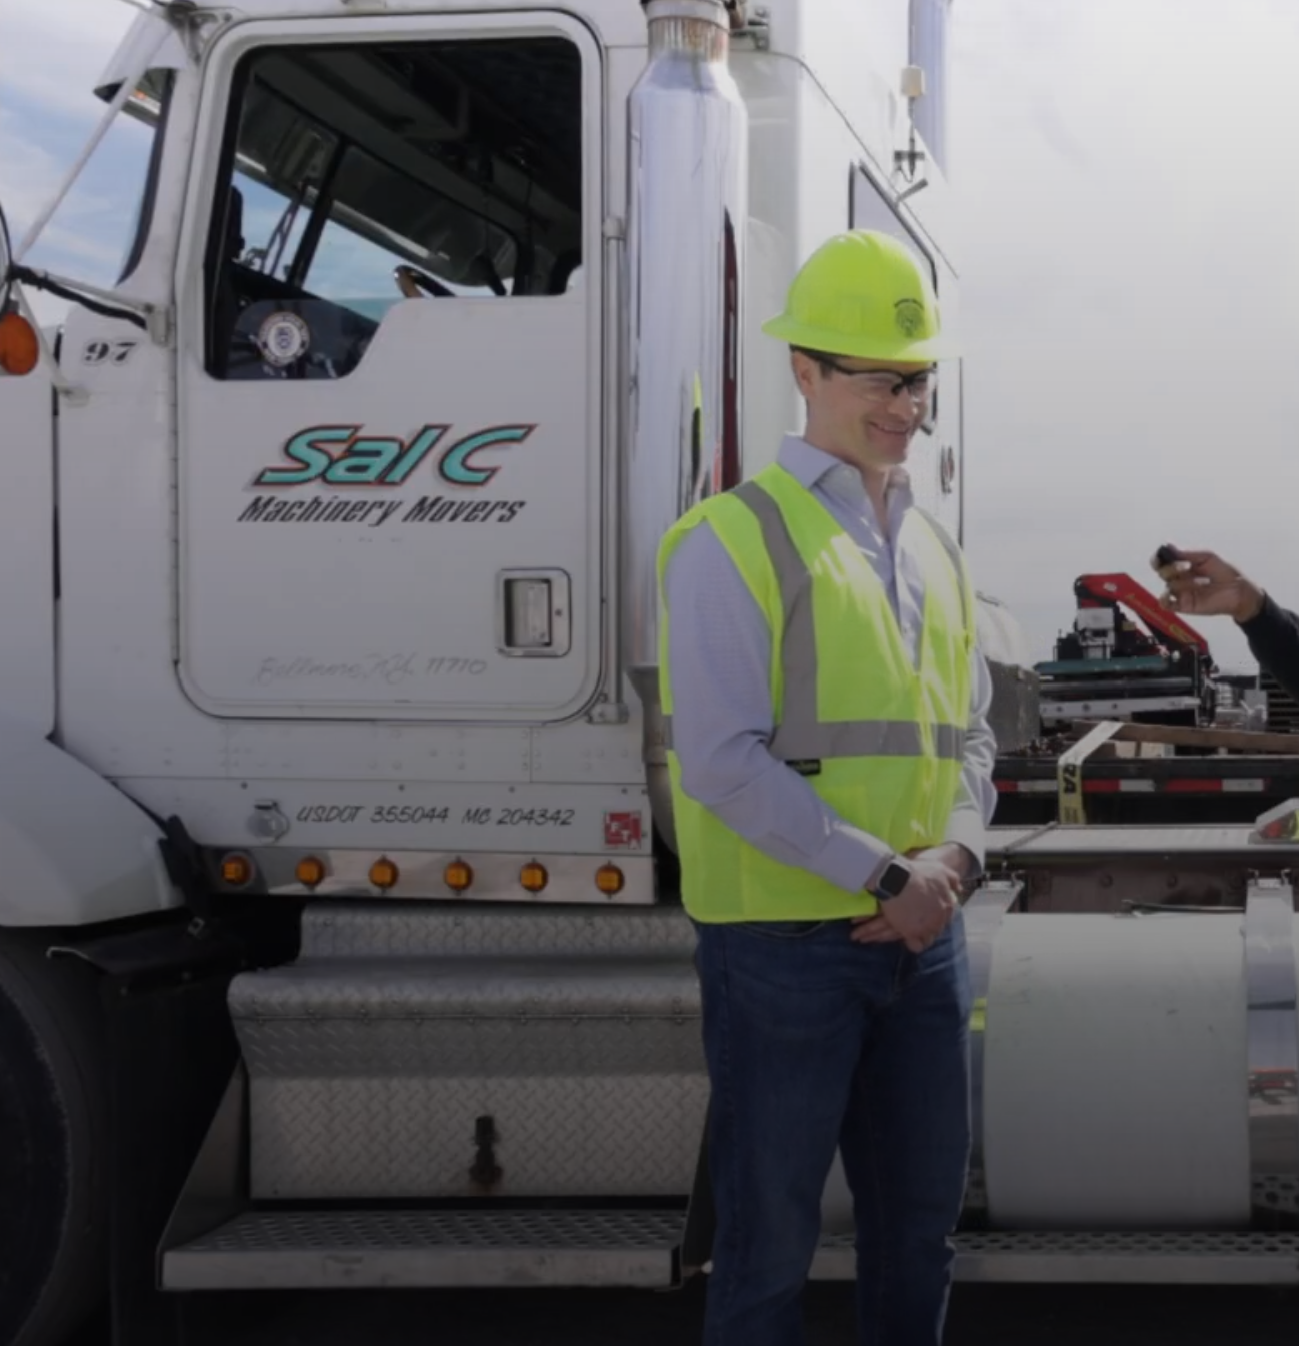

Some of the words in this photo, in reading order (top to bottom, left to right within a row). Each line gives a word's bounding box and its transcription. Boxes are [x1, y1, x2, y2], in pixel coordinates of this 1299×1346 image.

[84, 340, 137, 362] 97
[252, 424, 453, 486] Sal
[438, 424, 538, 486] C
[236, 495, 403, 527] Machinery
[401, 495, 527, 523] Movers
[425, 656, 488, 676] 11710
[296, 805, 365, 824] USDOT
[370, 805, 451, 824] 355044
[460, 807, 493, 825] MC
[495, 808, 576, 826] 204342
